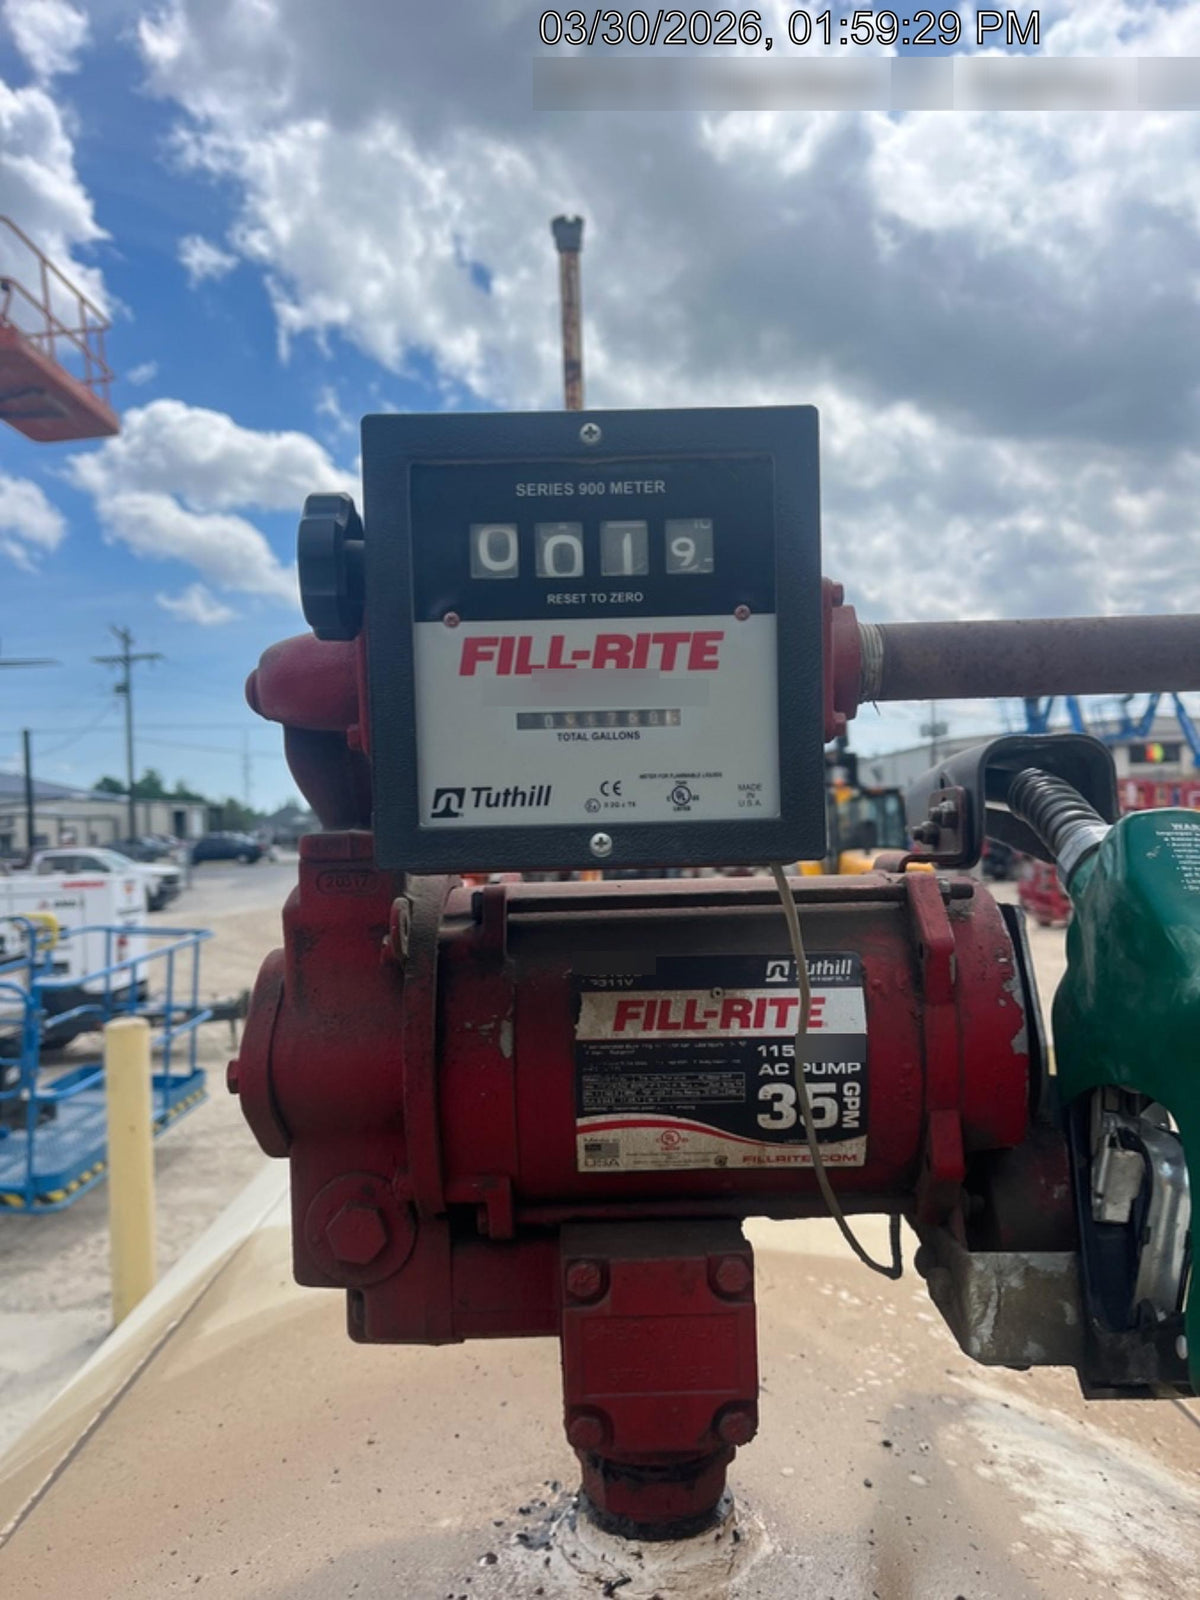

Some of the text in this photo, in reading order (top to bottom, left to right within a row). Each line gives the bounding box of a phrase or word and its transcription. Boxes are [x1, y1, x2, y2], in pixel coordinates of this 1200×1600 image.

[516, 480, 666, 497] SERIES 900 METER
[546, 591, 644, 605] RESET TO ZERO
[458, 631, 724, 676] FILL-RITE
[557, 730, 641, 742] TOTAL GALLONS
[471, 784, 552, 808] Tuthill
[738, 783, 763, 792] MADE
[613, 996, 826, 1032] FILL-RITE
[758, 1062, 790, 1076] AC
[757, 1082, 838, 1130] 35
[842, 1081, 861, 1129] GPM
[743, 1153, 858, 1164] FILLRITECOM
